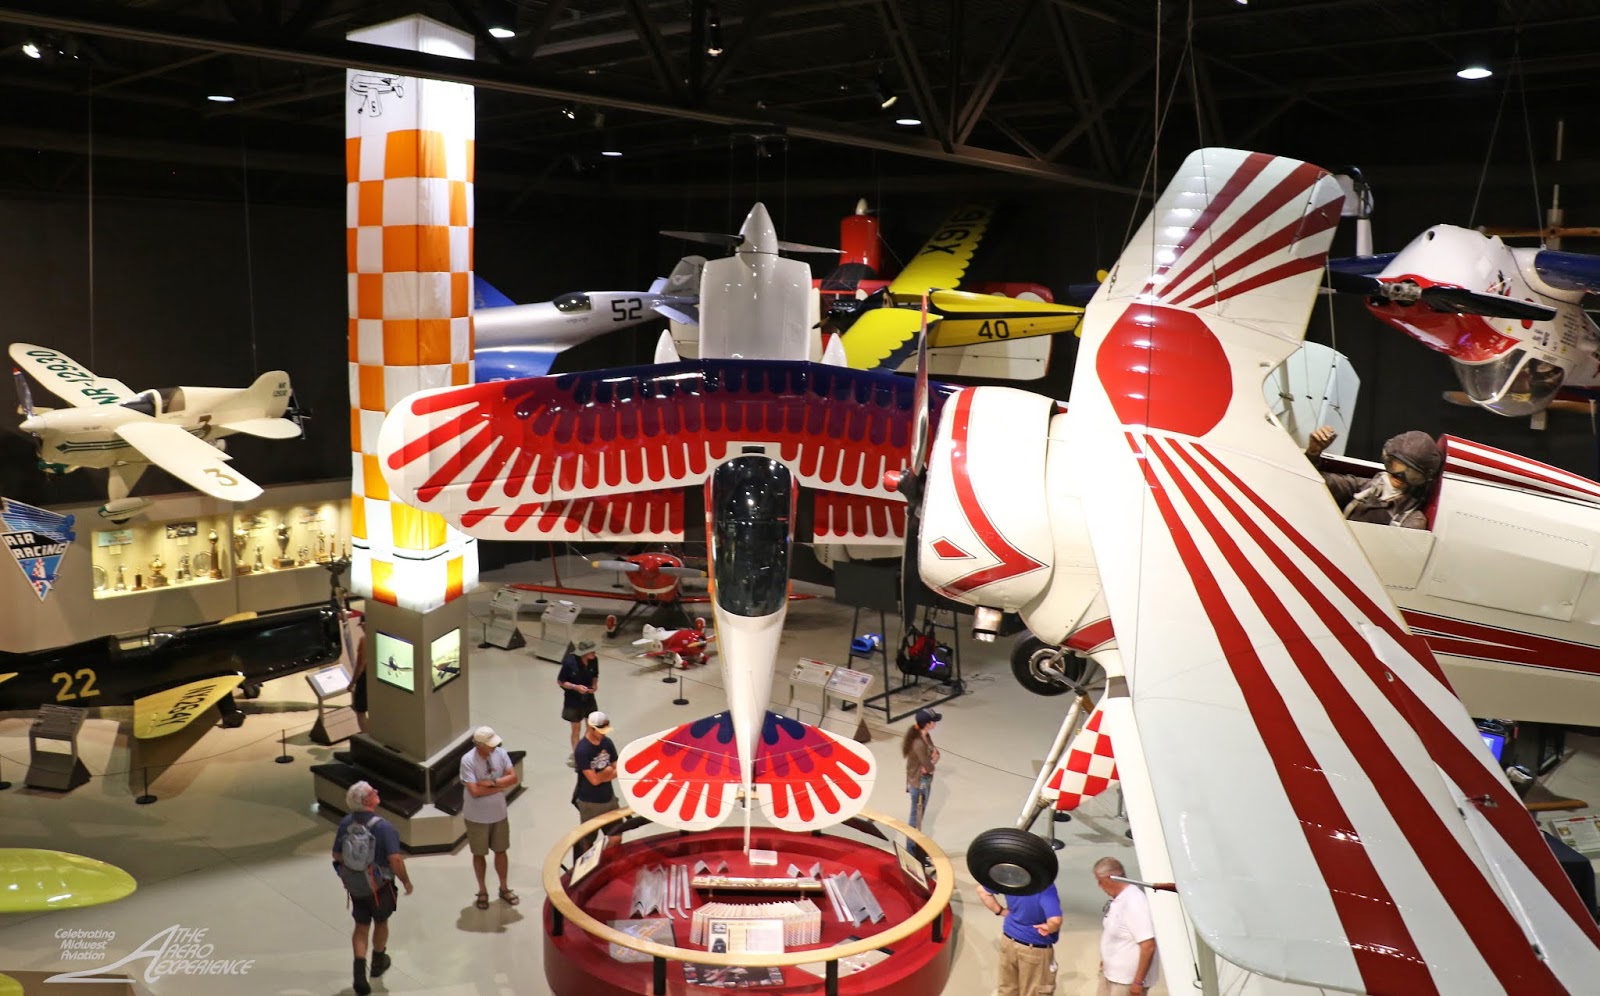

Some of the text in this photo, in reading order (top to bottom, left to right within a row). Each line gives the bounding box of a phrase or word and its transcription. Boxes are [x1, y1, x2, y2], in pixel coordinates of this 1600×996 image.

[611, 297, 643, 322] 52
[977, 319, 1010, 340] 40
[25, 350, 121, 405] NR-12930
[203, 467, 239, 487] 3
[51, 667, 101, 702] 22
